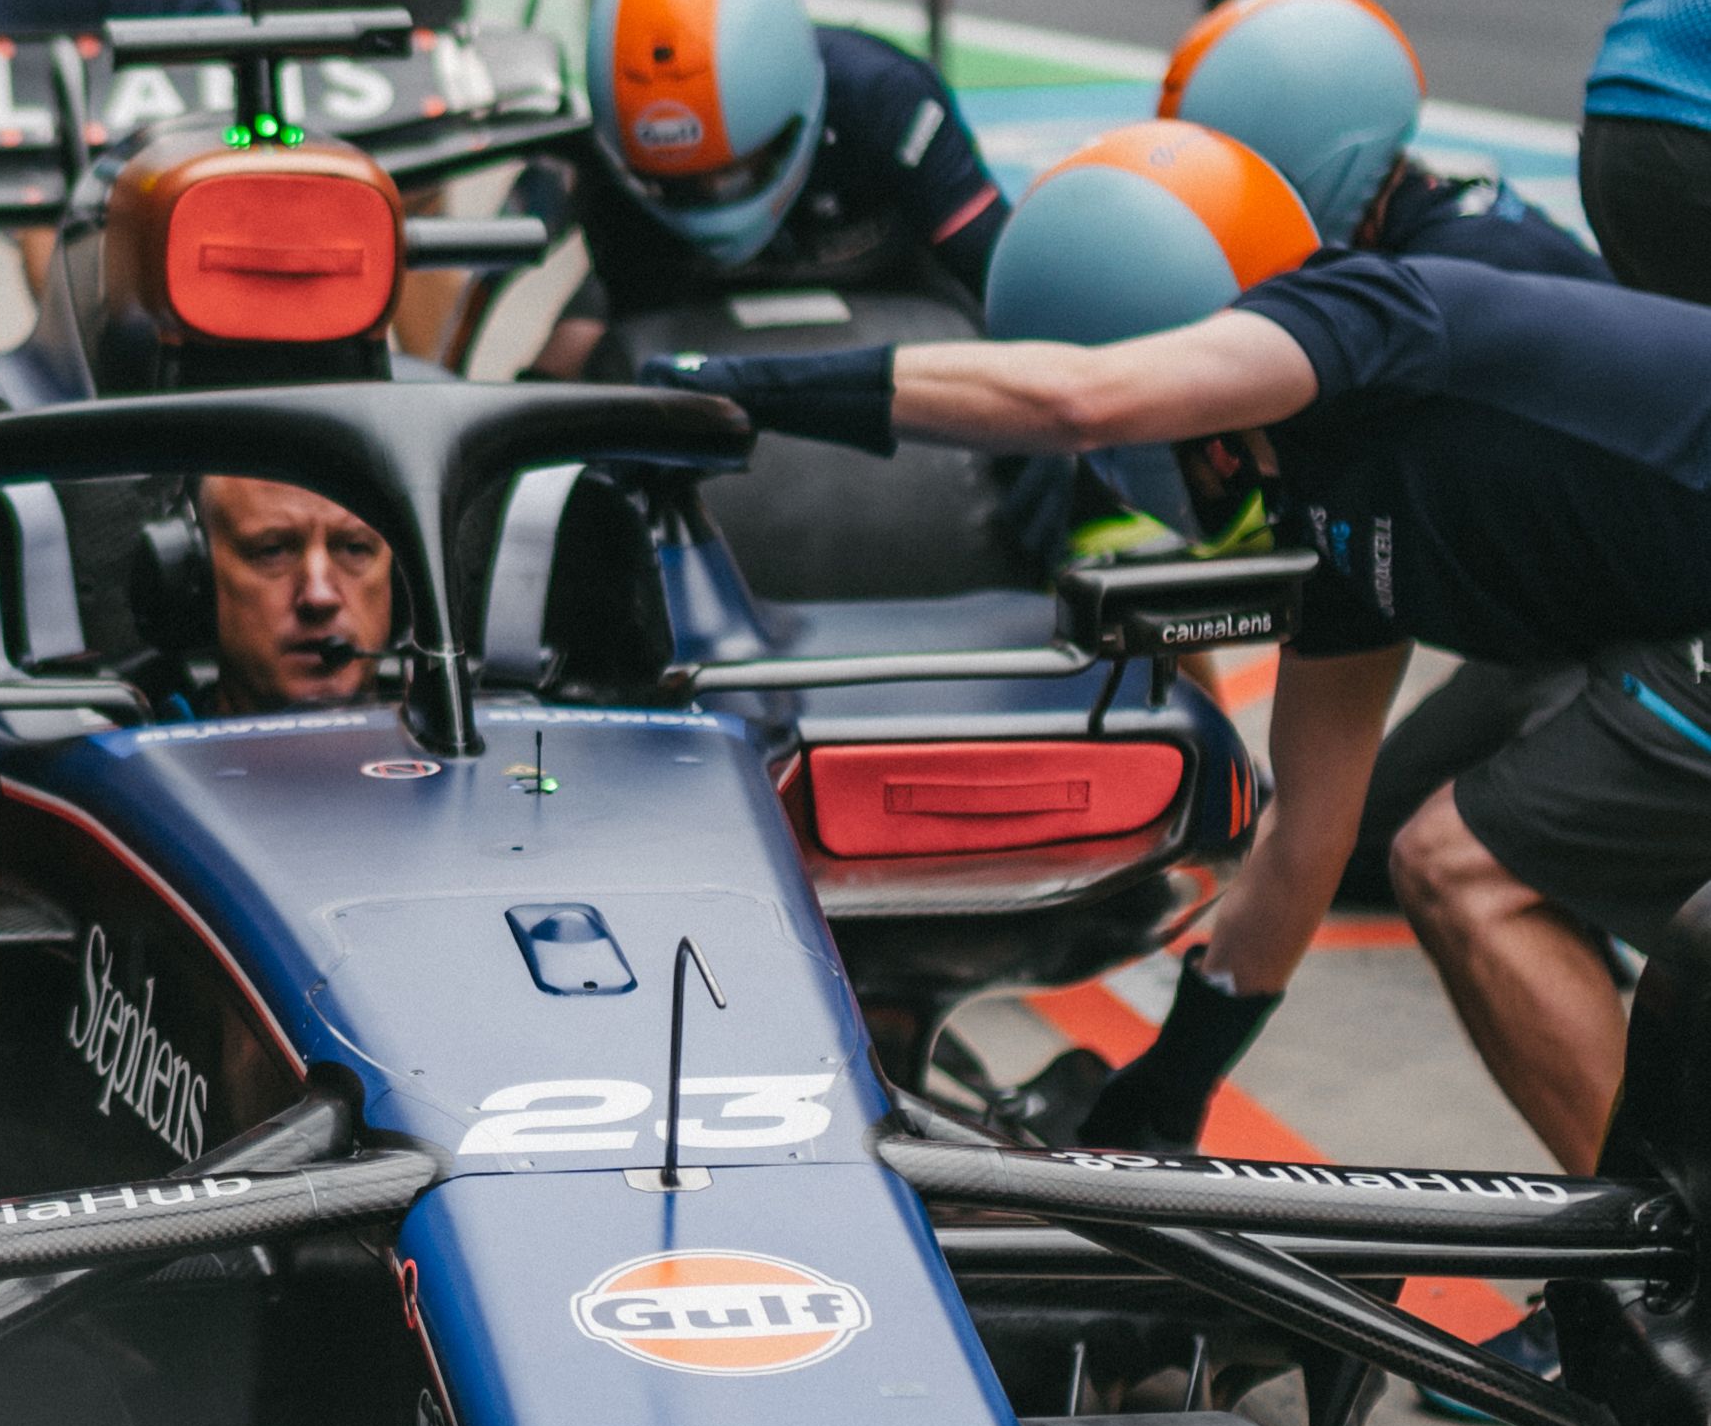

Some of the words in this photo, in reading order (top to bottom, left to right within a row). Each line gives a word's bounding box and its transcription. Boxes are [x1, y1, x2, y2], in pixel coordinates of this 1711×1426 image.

[1162, 612, 1273, 644] causaLens
[68, 924, 207, 1163] Stephens
[456, 1073, 837, 1156] 23
[1203, 1159, 1570, 1205] JuliaHub
[590, 1293, 846, 1332] Gulf
